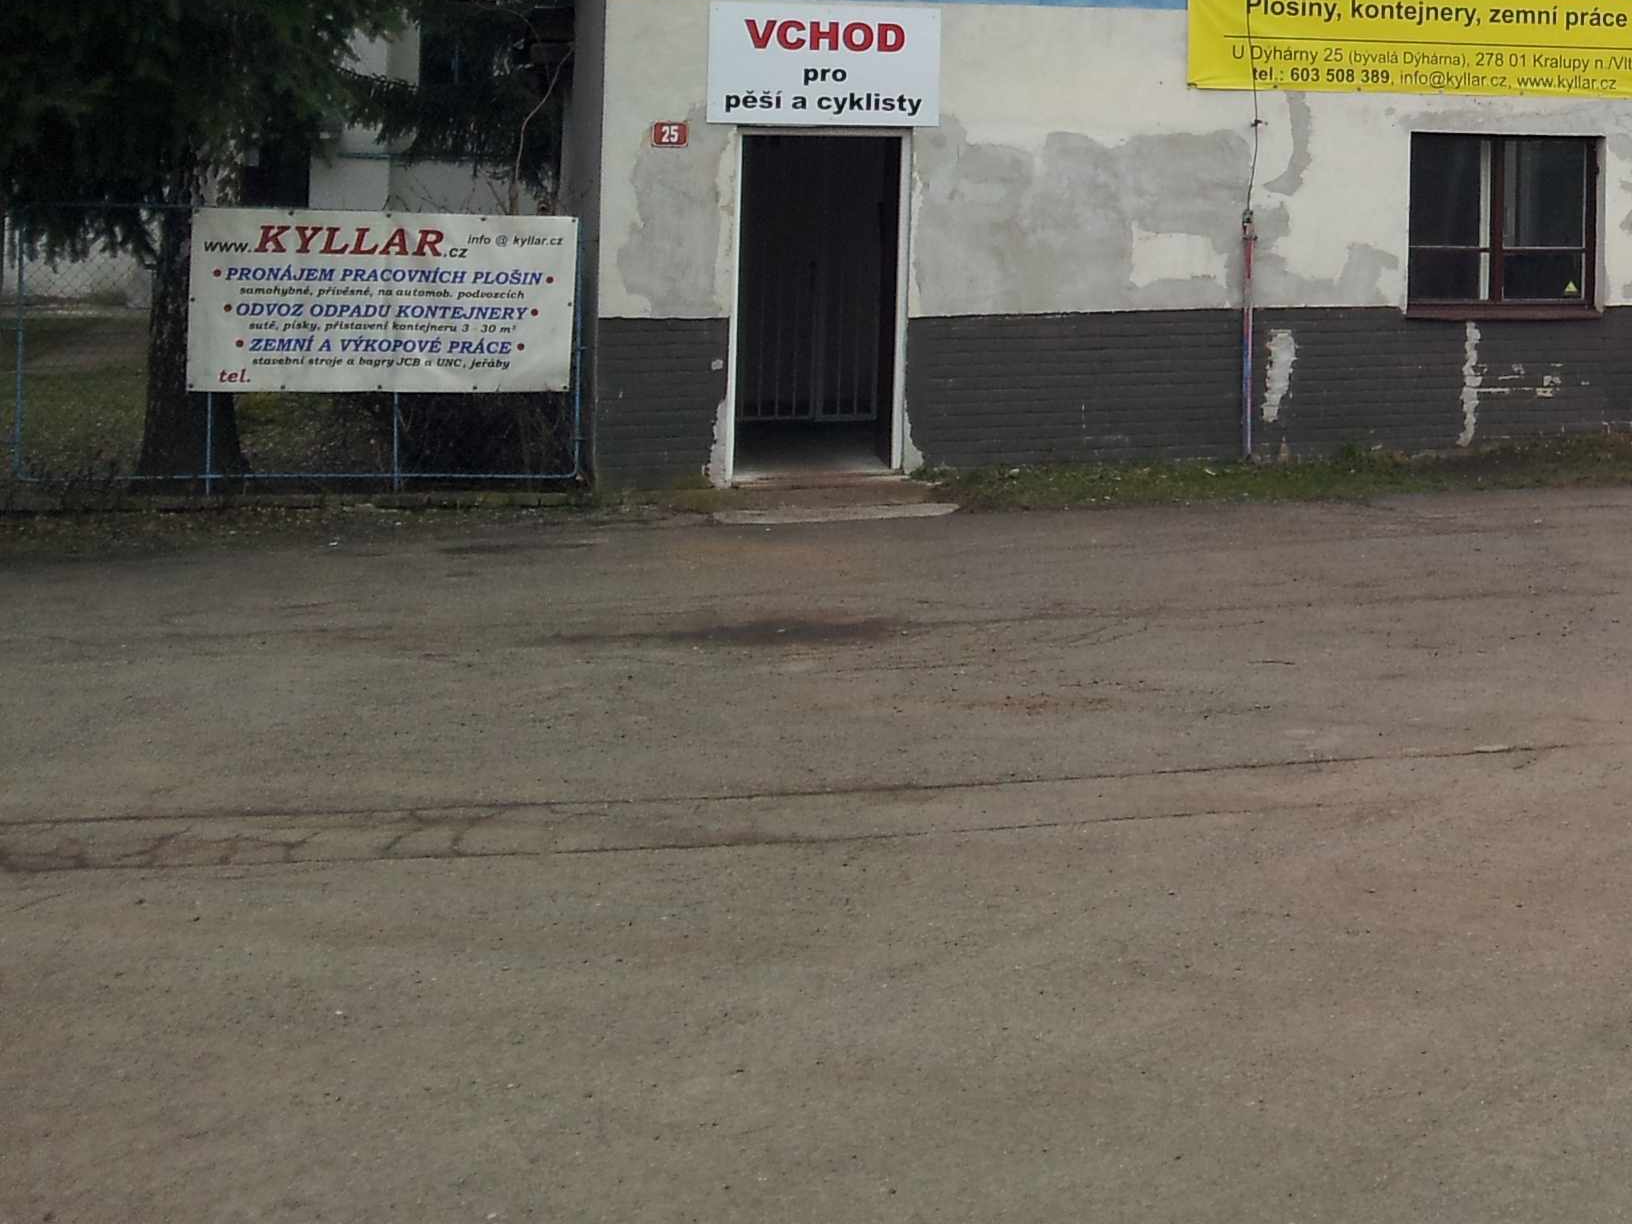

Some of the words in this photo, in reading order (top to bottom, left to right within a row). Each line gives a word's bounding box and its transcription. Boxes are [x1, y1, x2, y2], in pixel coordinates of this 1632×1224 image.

[1350, 0, 1481, 27] kontejnery,
[1489, 6, 1558, 25] zemní
[1565, 7, 1628, 30] práce
[745, 19, 906, 52] VCHOD
[1232, 44, 1245, 59] U
[1251, 44, 1319, 65] Dýhárny
[1324, 47, 1343, 62] 25
[1349, 49, 1398, 66] (bývalá
[1403, 51, 1470, 68] Dýhárna),
[1475, 52, 1504, 67] 278
[1509, 54, 1527, 67] 01
[1533, 54, 1589, 73] Kralupy
[803, 66, 848, 86] pro
[1253, 67, 1284, 81] tel.:
[1290, 67, 1320, 82] 603
[1326, 68, 1355, 83] 508
[1361, 69, 1394, 85] 389,
[1400, 70, 1512, 90] info@kyllar.cz,
[1517, 75, 1617, 92] www.kyllar.cz
[725, 90, 782, 113] pěší
[791, 96, 807, 110] a
[817, 92, 923, 116] cyklisty
[661, 126, 679, 144] 25
[467, 235, 491, 245] info
[495, 234, 508, 247] @
[513, 235, 564, 247] kyllar.cz
[225, 264, 336, 282] PRONÁJEM
[340, 266, 467, 285] PRACOVNÍCH
[471, 269, 543, 286] PLOŠIN
[239, 286, 313, 297] samohybné,
[316, 286, 373, 298] přívěsné,
[396, 288, 453, 299] automob.
[456, 289, 525, 301] podvozcích
[236, 302, 303, 317] ODVOZ
[309, 303, 391, 318] ODPADU
[395, 305, 529, 321] KONTEJNERY
[282, 321, 321, 332] písky,
[392, 322, 457, 334] kontejneru
[482, 324, 497, 333] 30
[249, 335, 315, 352] ZEMNÍ
[318, 338, 332, 352] A
[340, 336, 442, 354] VÝKOPOVÉ
[447, 338, 513, 355] PRÁCE
[252, 355, 304, 366] stavební
[307, 356, 342, 367] stroje
[358, 356, 394, 368] bagry
[395, 357, 421, 367] JCB
[424, 359, 432, 367] a
[436, 358, 467, 369] UNC,
[469, 358, 511, 370] jeřáby
[219, 368, 251, 384] tel.
